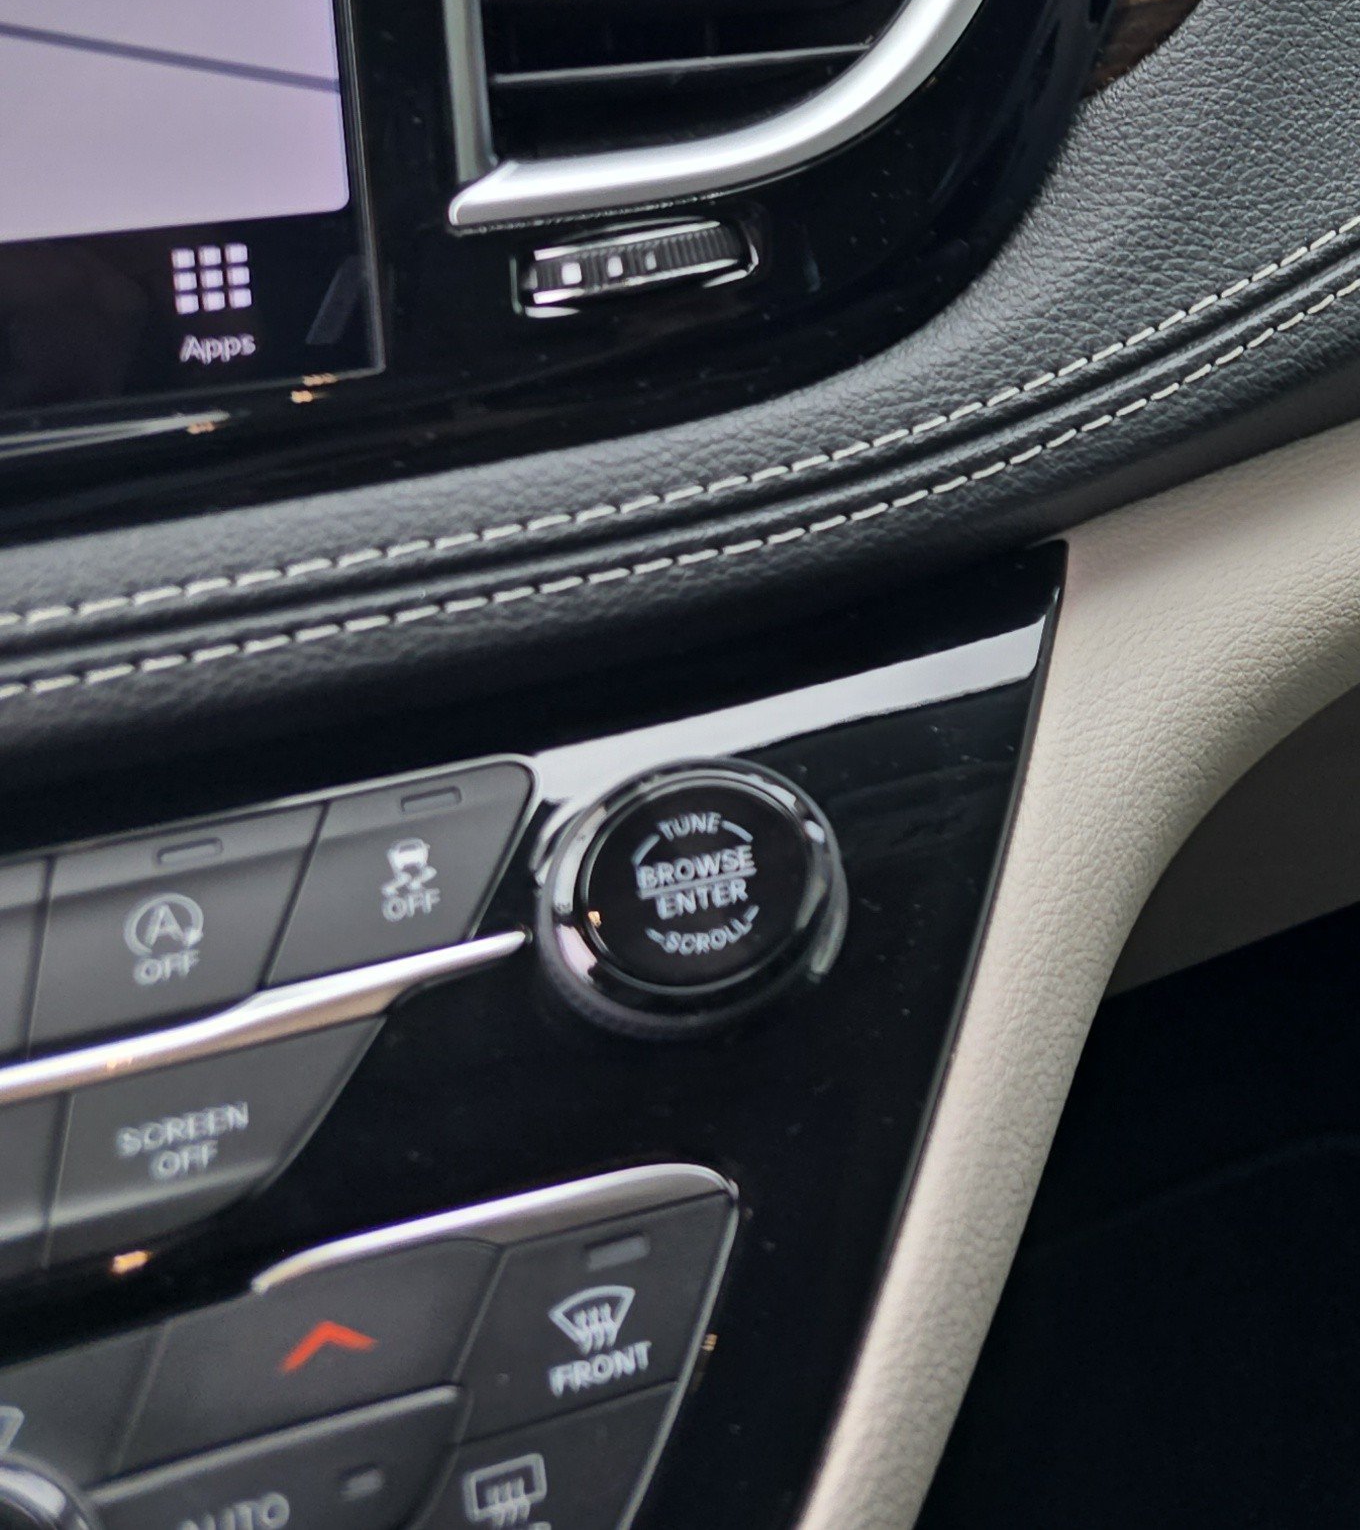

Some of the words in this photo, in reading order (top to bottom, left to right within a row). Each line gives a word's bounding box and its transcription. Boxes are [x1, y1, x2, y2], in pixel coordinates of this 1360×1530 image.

[180, 333, 257, 365] Apps
[657, 811, 722, 842] TUNE
[635, 844, 756, 890] BROWSE
[381, 888, 441, 922] OFF
[655, 878, 749, 921] ENTER
[662, 917, 754, 956] SCROLL
[133, 948, 201, 986] OFF
[114, 1100, 250, 1158] SCREEN
[149, 1139, 219, 1181] OFF
[549, 1340, 653, 1399] FRONT
